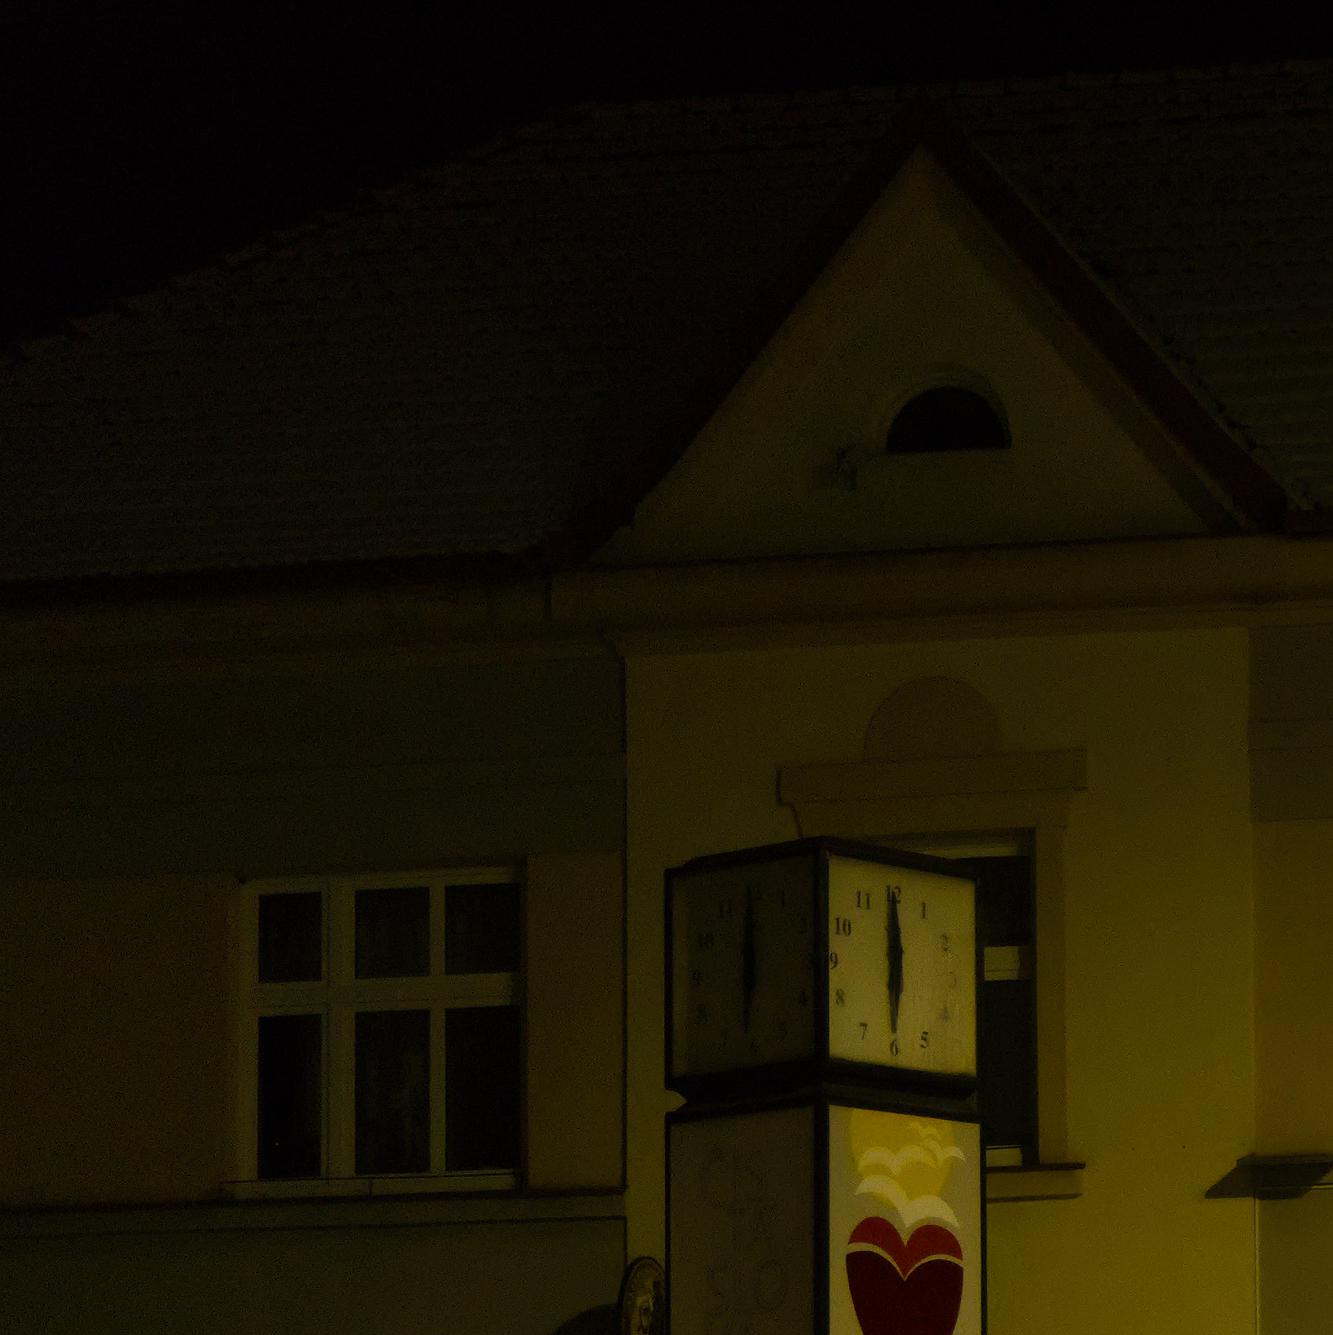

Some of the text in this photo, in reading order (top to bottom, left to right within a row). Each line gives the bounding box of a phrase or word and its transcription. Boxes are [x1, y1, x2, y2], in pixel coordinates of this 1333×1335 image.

[856, 891, 871, 910] 11
[921, 902, 928, 919] 1
[834, 917, 851, 936] 10
[836, 989, 845, 1006] 8
[859, 1023, 868, 1040] 7
[920, 1031, 929, 1049] 5
[889, 1039, 898, 1056] 6
